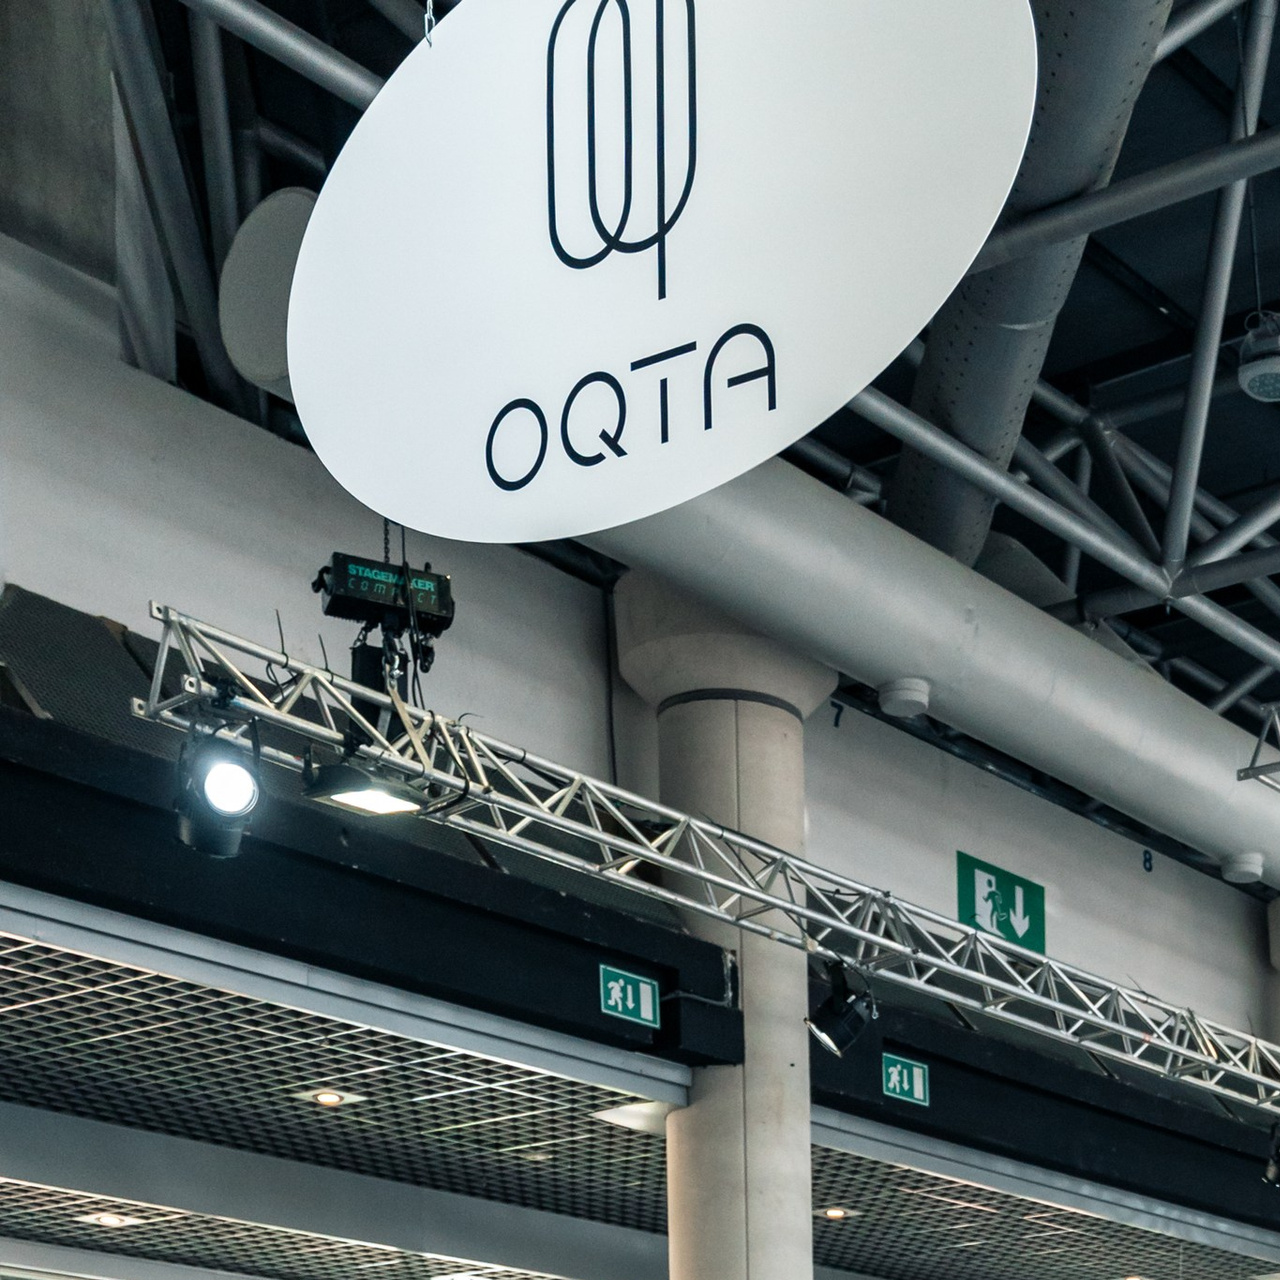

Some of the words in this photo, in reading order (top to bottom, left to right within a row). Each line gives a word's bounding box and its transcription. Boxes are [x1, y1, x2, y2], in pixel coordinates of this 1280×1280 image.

[485, 322, 777, 492] OQTA
[830, 700, 844, 728] 7
[1143, 849, 1153, 873] 8
